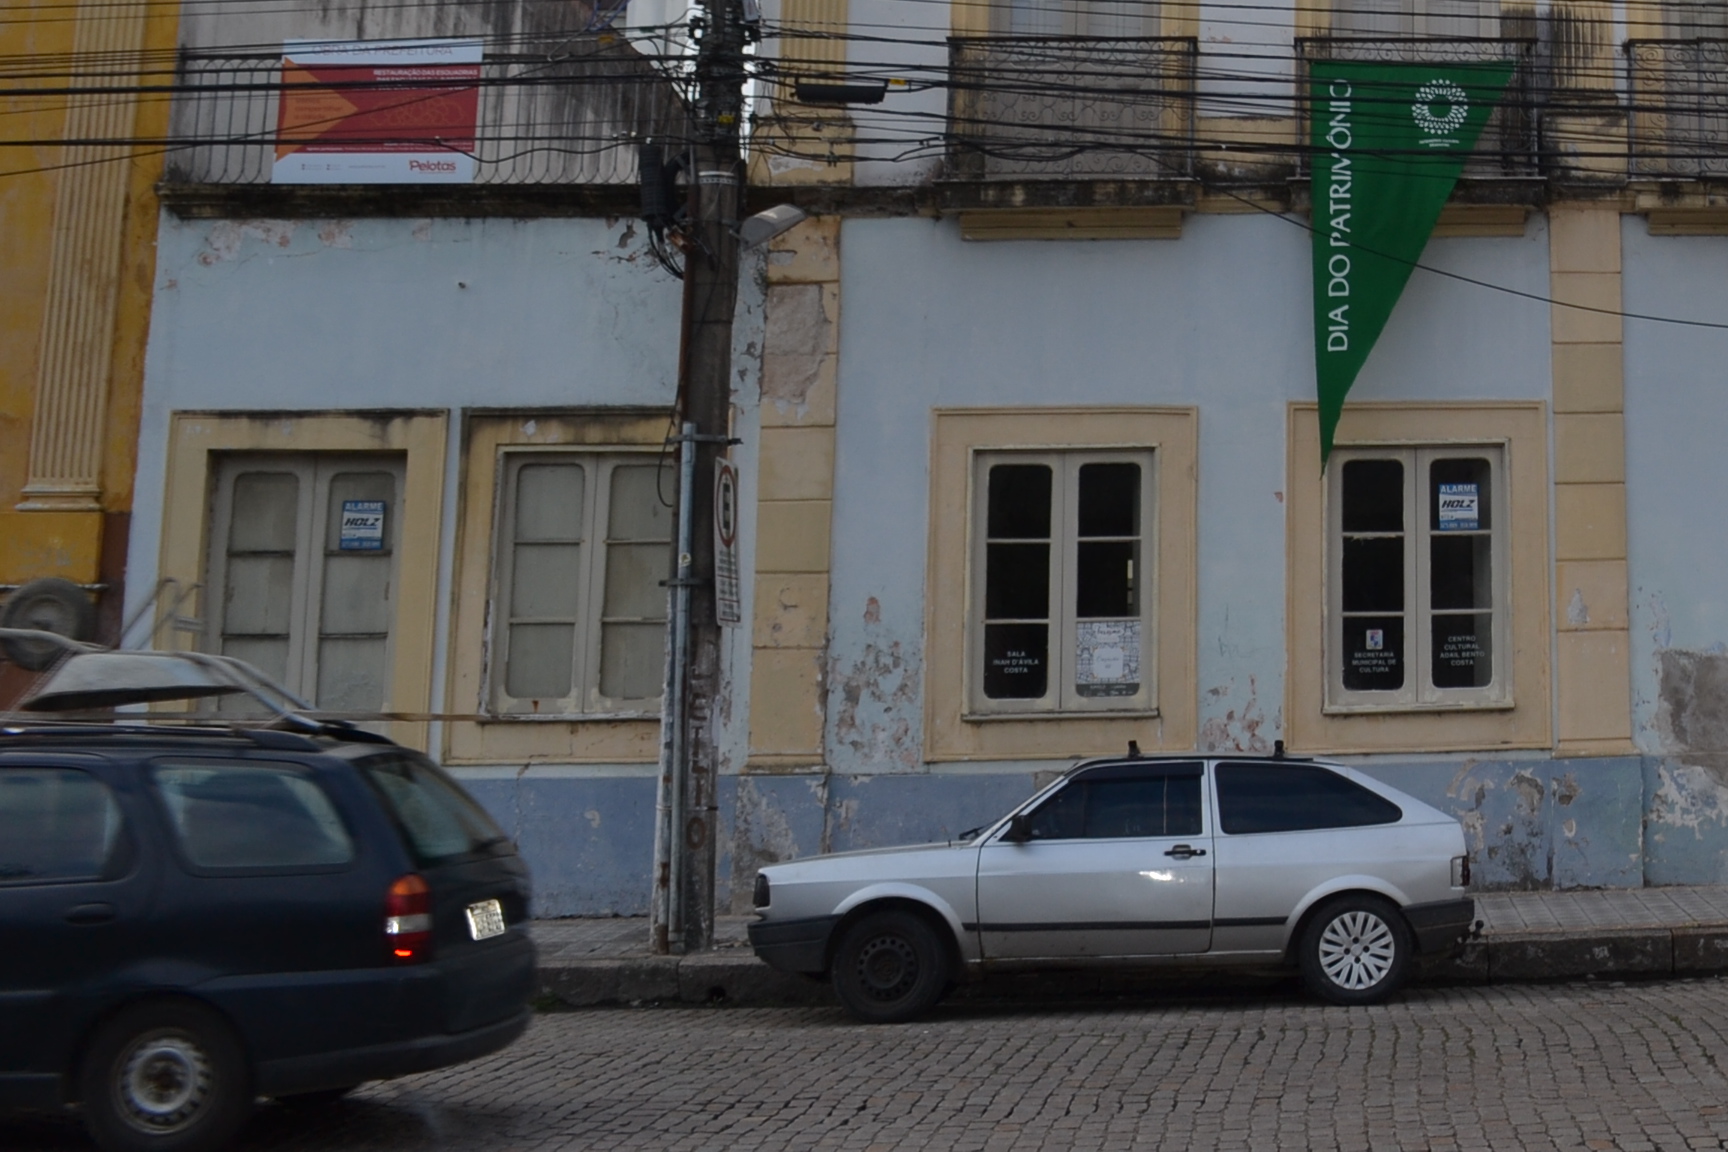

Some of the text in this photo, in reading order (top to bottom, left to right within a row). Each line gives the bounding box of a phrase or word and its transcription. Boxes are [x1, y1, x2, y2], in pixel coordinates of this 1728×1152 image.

[352, 45, 369, 56] DA
[374, 44, 453, 56] PREFEITURA
[409, 159, 456, 171] Pelotas
[1325, 79, 1351, 352] DIA DO PATRIMÔNIO
[1440, 484, 1477, 493] ALARME
[345, 502, 383, 511] ALARME
[1442, 499, 1475, 508] HOLZ
[344, 518, 381, 526] HOLZ
